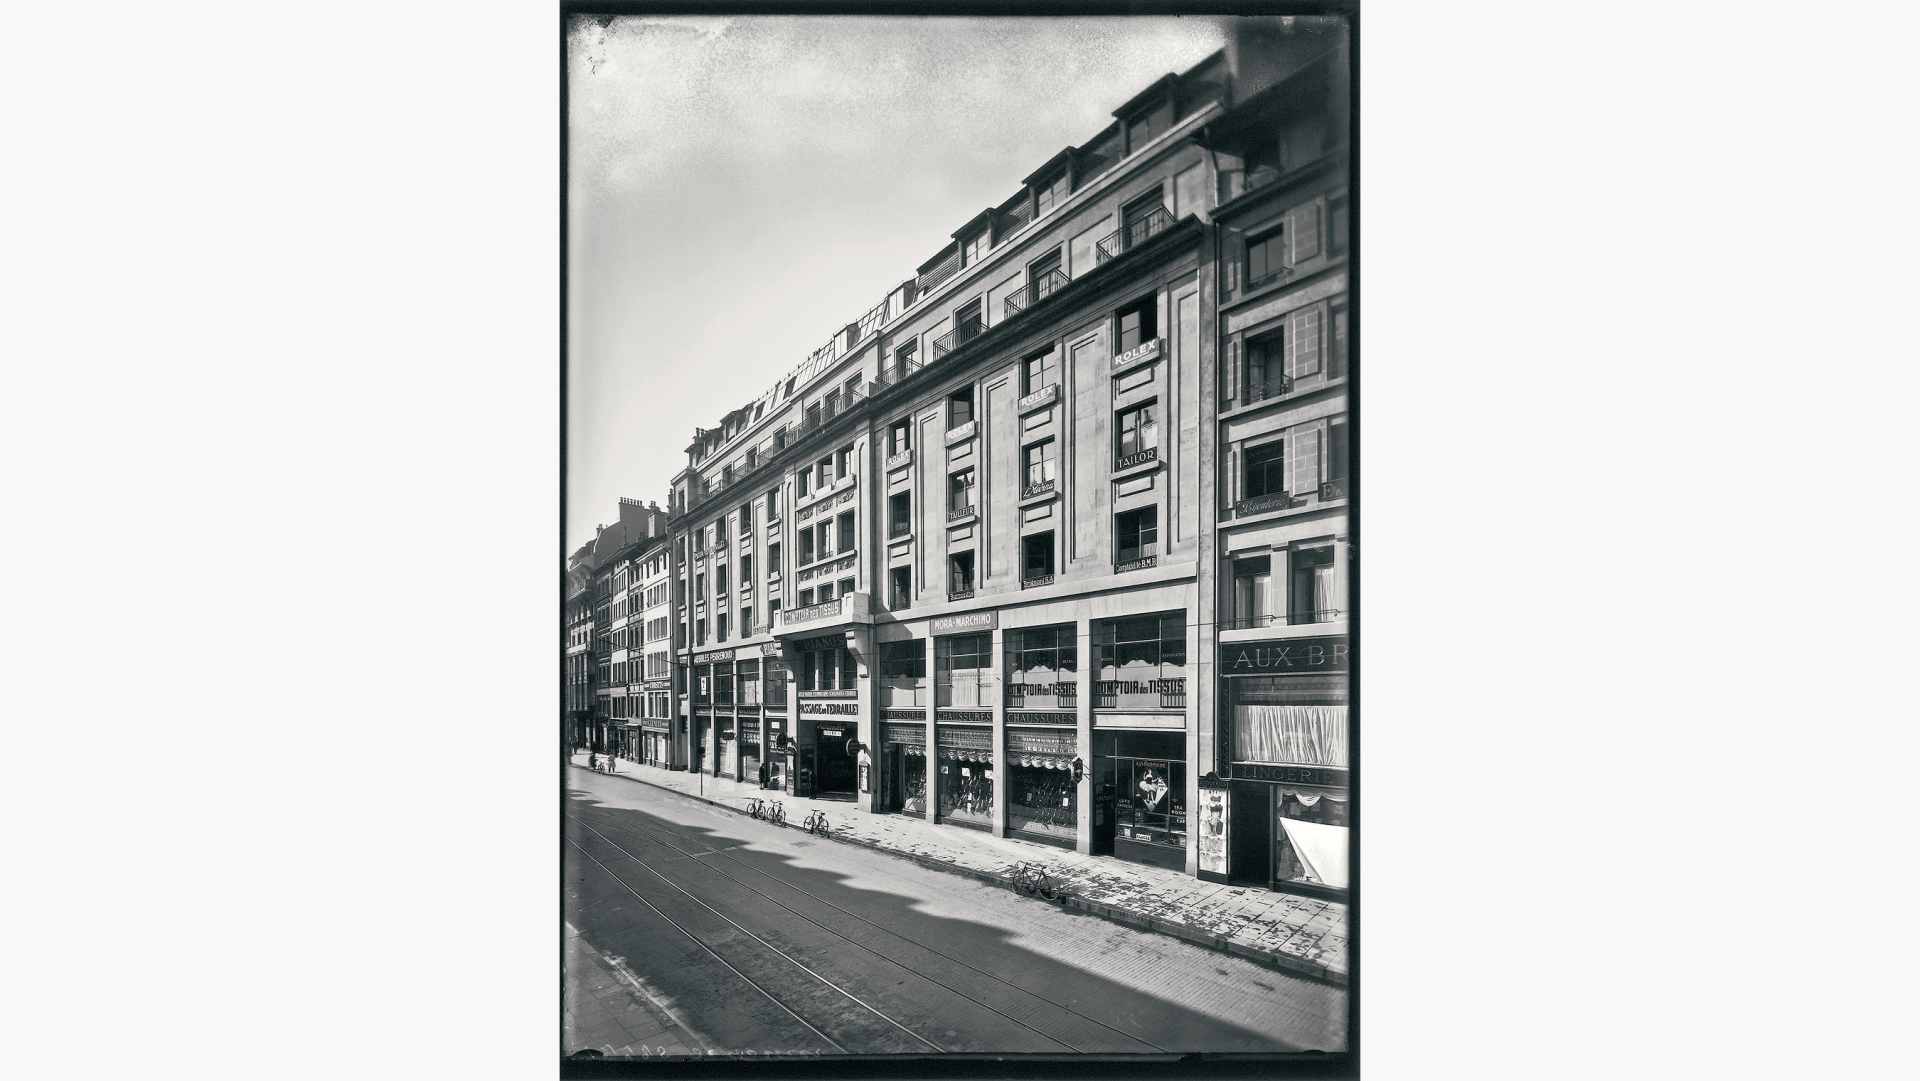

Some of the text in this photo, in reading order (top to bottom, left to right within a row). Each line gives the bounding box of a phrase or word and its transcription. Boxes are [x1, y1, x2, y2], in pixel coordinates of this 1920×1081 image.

[1115, 339, 1156, 364] ROLEX
[1021, 386, 1053, 406] ROLEX
[1119, 450, 1155, 468] TAILOR
[819, 600, 839, 616] TISSUS
[1233, 647, 1293, 669] AUX
[1048, 682, 1077, 696] TISSUS
[1148, 679, 1184, 694] TISSUS
[938, 711, 991, 721] CHAUSSURES
[1008, 713, 1075, 723] CHAUSSURES
